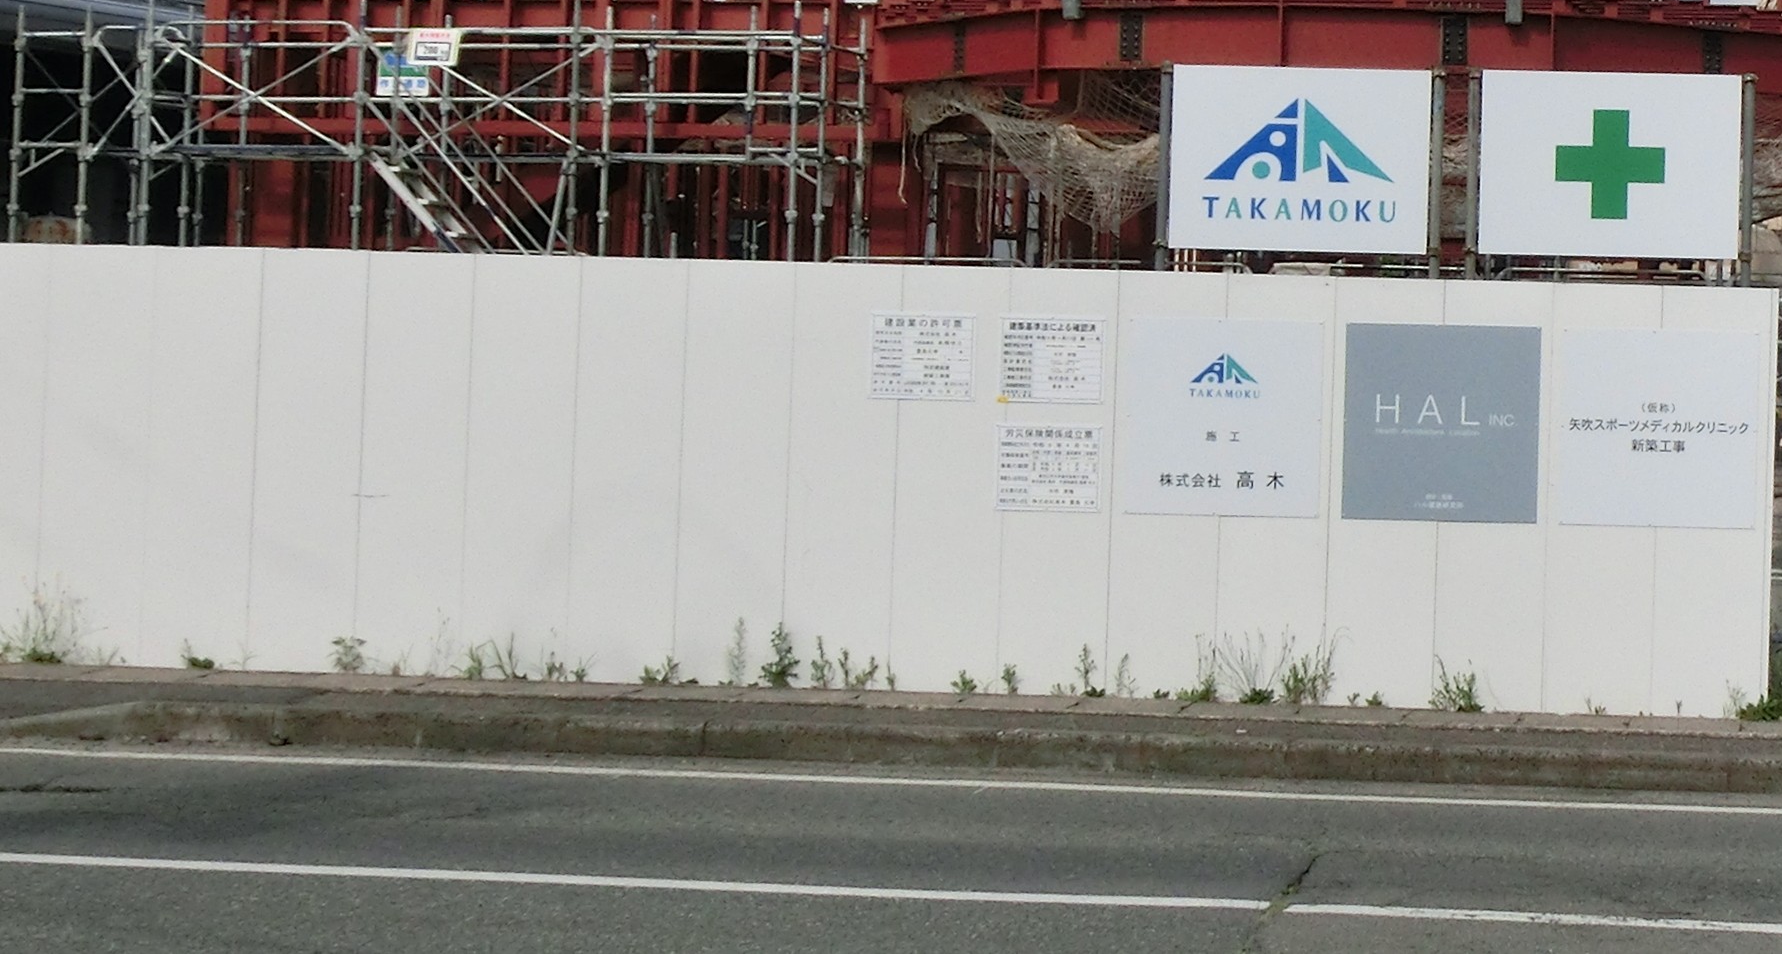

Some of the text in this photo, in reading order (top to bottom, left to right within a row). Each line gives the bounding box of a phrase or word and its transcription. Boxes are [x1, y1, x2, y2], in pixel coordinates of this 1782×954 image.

[1202, 196, 1397, 224] TAKAMOKU
[1189, 388, 1262, 399] TAKAMOKU
[1374, 392, 1481, 427] HAL
[1568, 417, 1750, 435] 矢吹スポーツメディカルクリニック
[1631, 438, 1687, 454] 新築工事
[1159, 470, 1285, 490] 株式会社 高木
